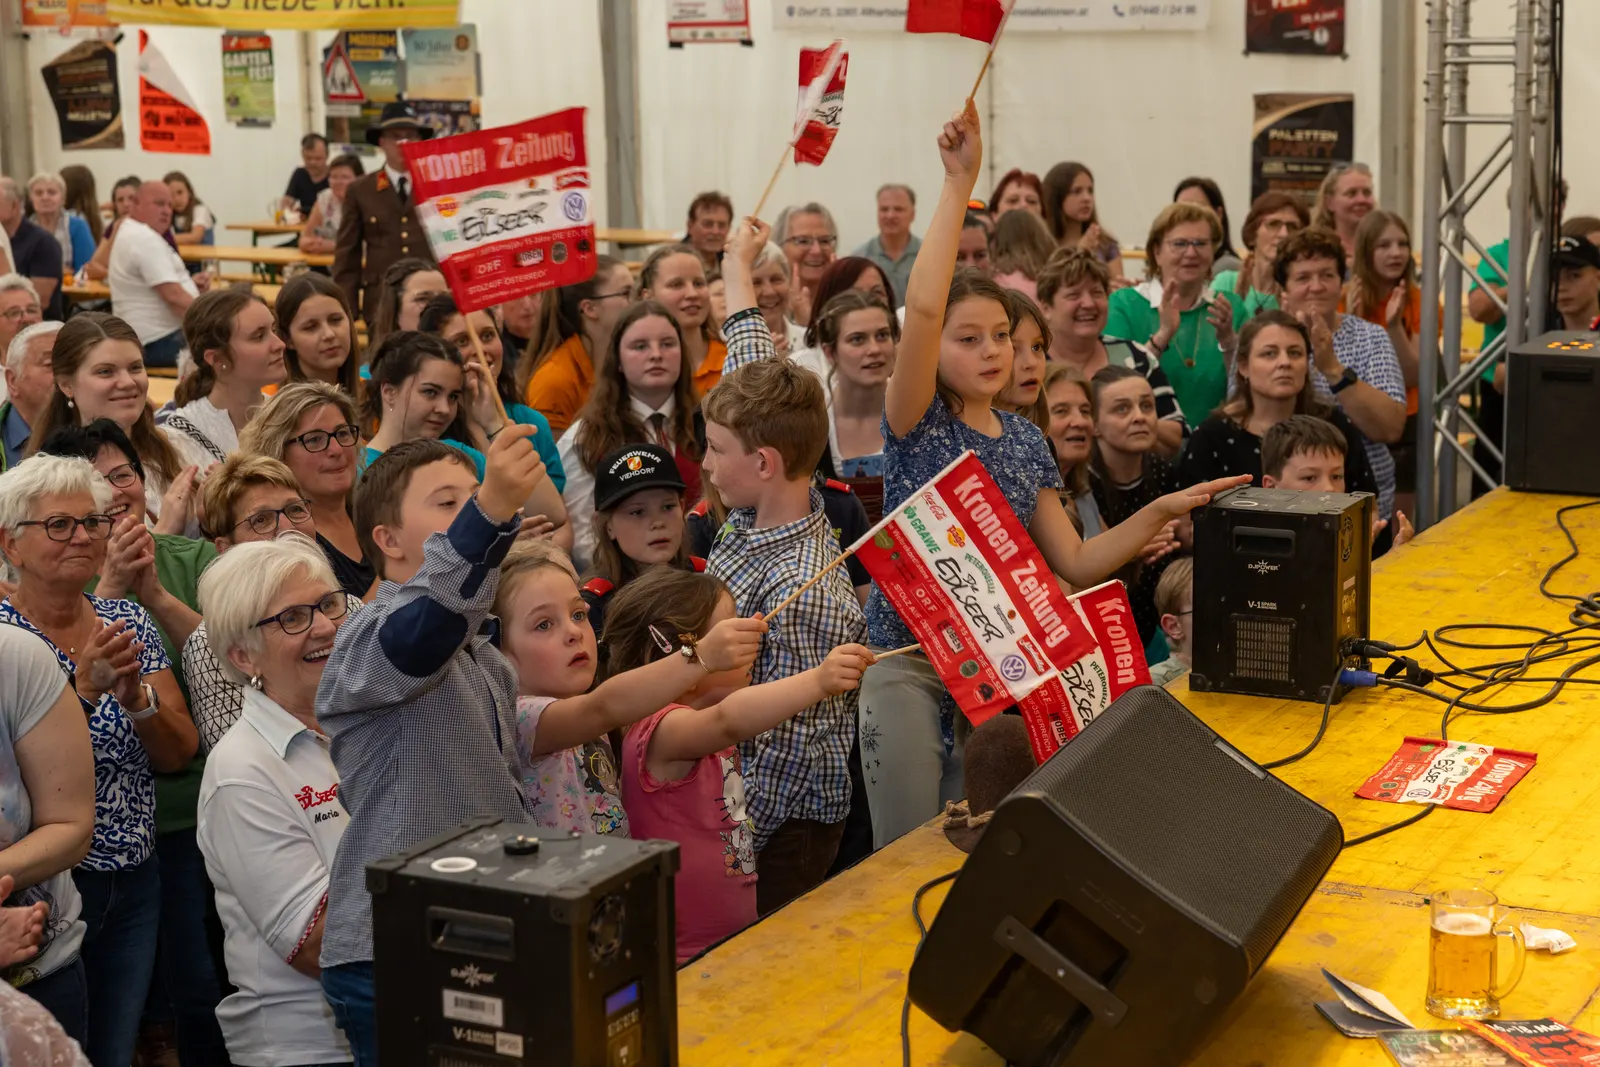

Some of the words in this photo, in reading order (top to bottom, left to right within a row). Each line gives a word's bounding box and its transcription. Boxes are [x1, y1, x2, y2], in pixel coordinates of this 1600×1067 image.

[223, 52, 270, 68] GARTEN
[249, 65, 274, 81] FEST
[1268, 128, 1338, 142] PALETTEN
[494, 131, 576, 170] Zeitung
[609, 450, 661, 474] FEUERWEHR
[619, 467, 655, 481] VIEHDORF
[910, 517, 941, 555] GRAWE
[952, 474, 1019, 563] Kronen
[1010, 558, 1072, 649] Zeitung
[915, 588, 938, 613] ORF
[1247, 600, 1261, 609] V-1
[908, 604, 921, 620] AUF
[958, 626, 968, 636] 15
[978, 657, 988, 668] DIE
[1095, 597, 1137, 685] Kronen
[1090, 660, 1109, 710] PETERQUELLE
[314, 809, 340, 824] Maria
[453, 1026, 472, 1042] V-1
